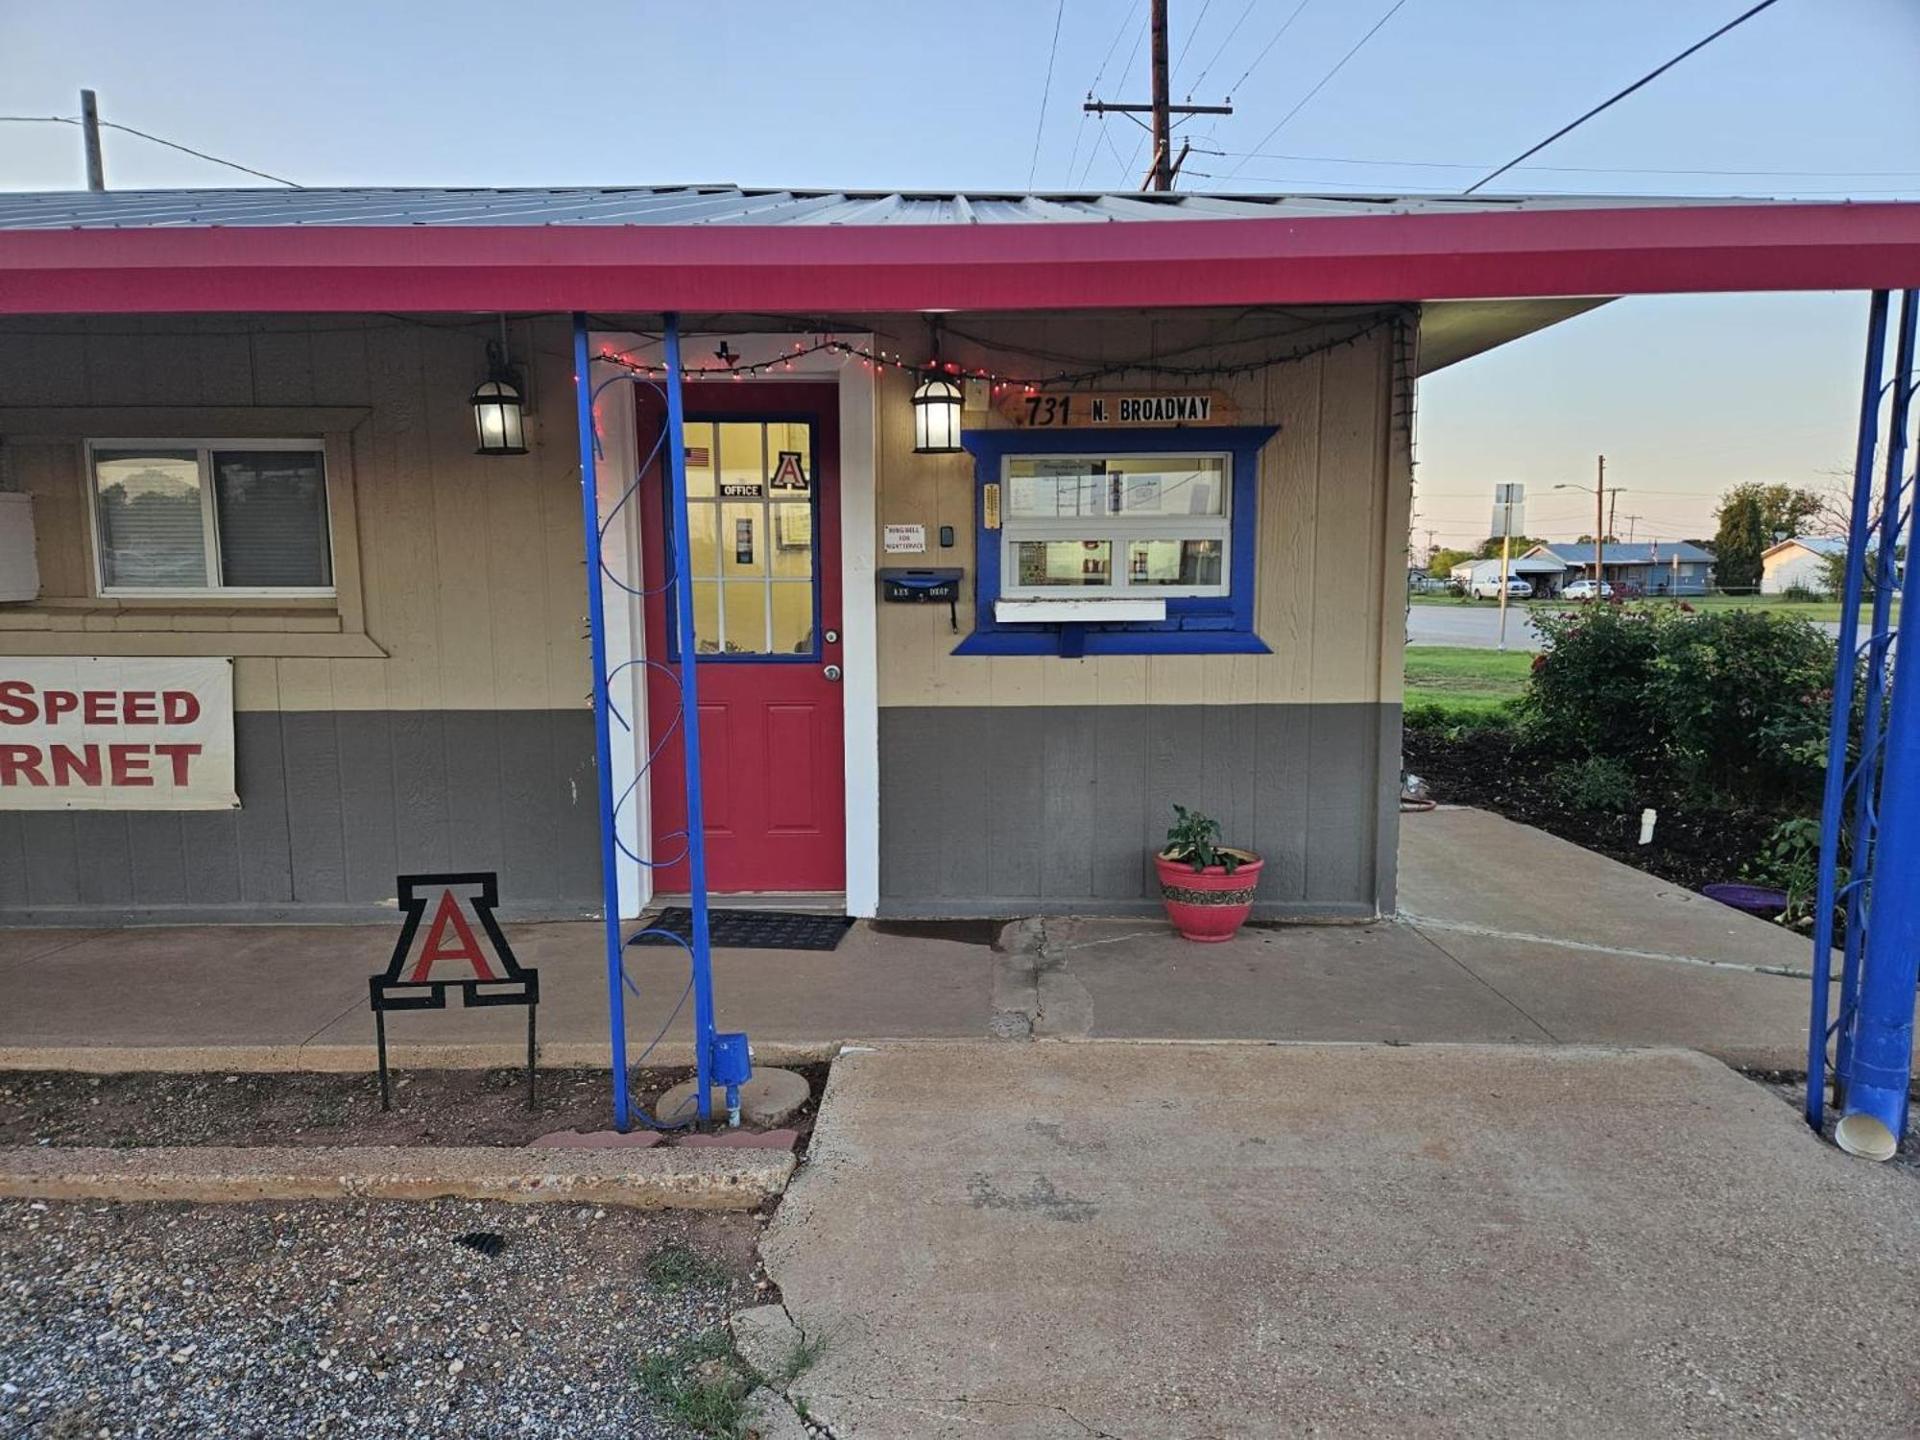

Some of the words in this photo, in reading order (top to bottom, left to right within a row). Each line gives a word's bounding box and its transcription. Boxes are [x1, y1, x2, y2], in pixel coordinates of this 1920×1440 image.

[1025, 397, 1070, 426] 731
[1093, 400, 1109, 421] N.
[1120, 397, 1210, 421] BROADWAY
[770, 451, 808, 490] A
[724, 485, 758, 495] OFFICE
[369, 872, 539, 1011] A
